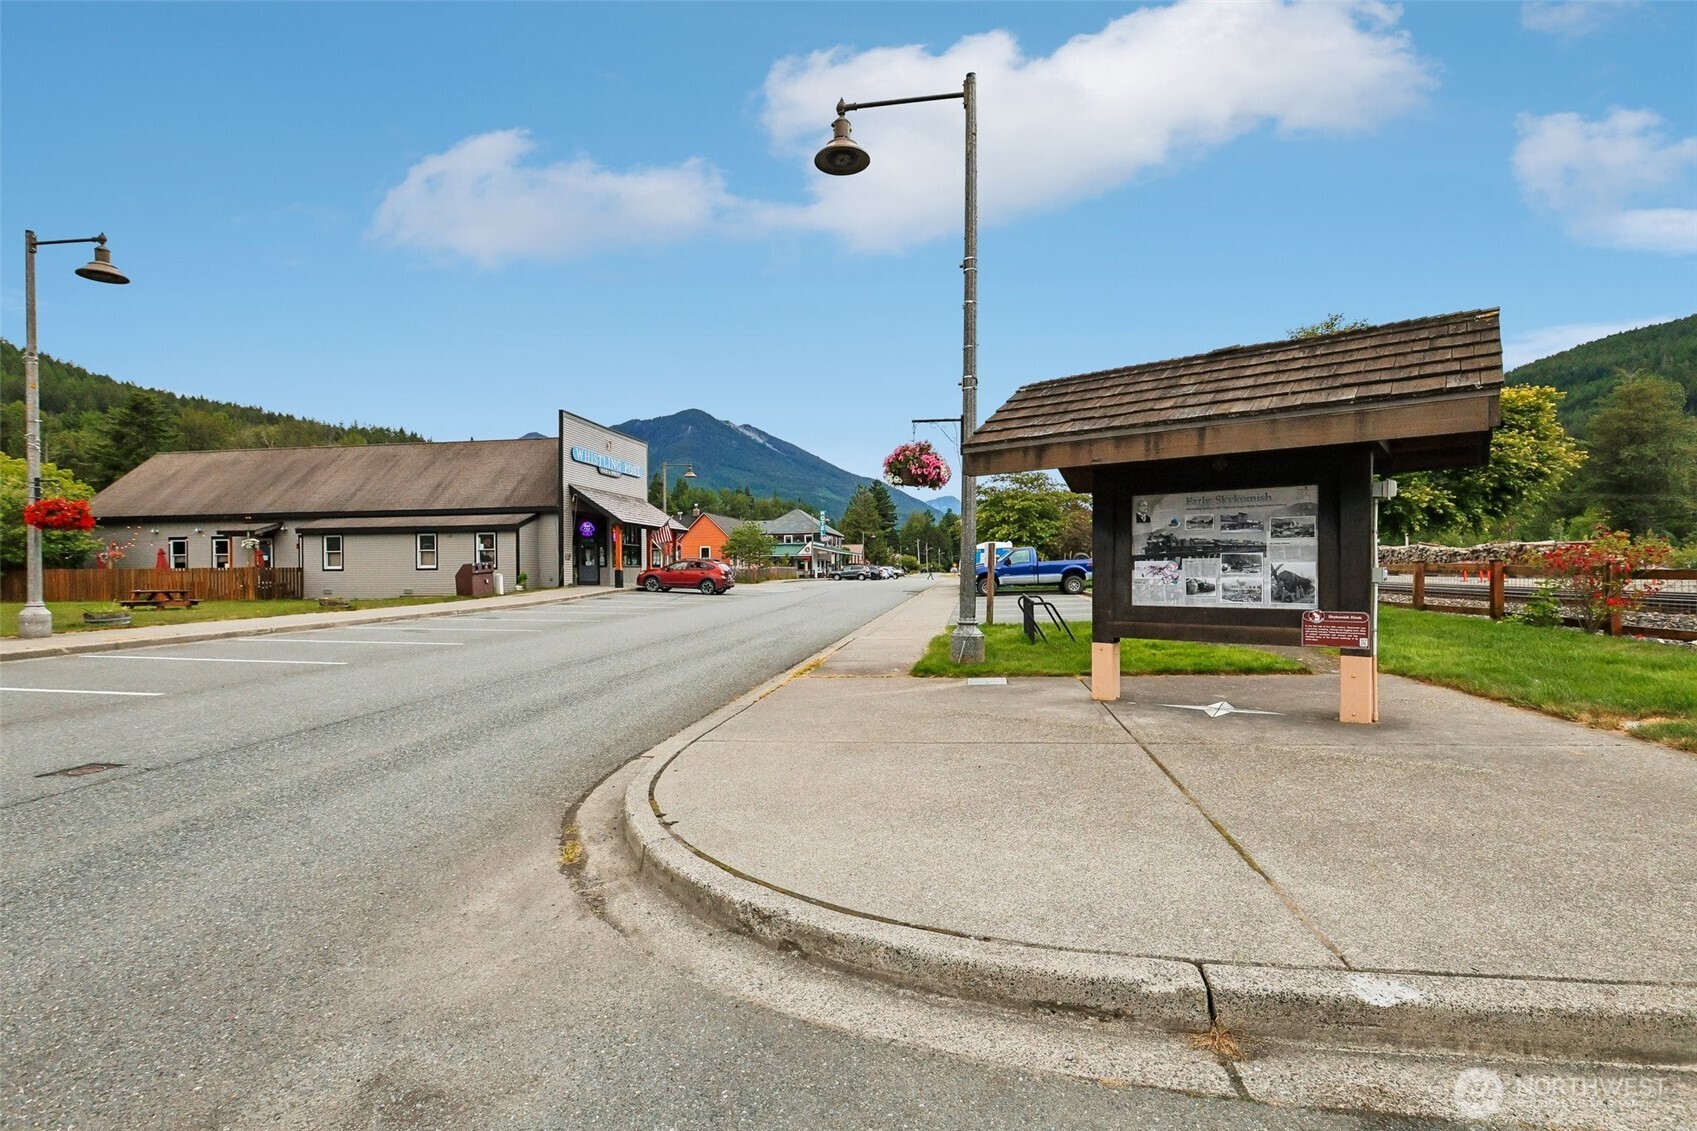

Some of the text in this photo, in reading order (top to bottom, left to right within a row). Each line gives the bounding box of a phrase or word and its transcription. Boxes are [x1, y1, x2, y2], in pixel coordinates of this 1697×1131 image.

[576, 447, 622, 472] WHISTLING
[624, 462, 641, 477] POST
[1186, 492, 1272, 506] Early Skykomish
